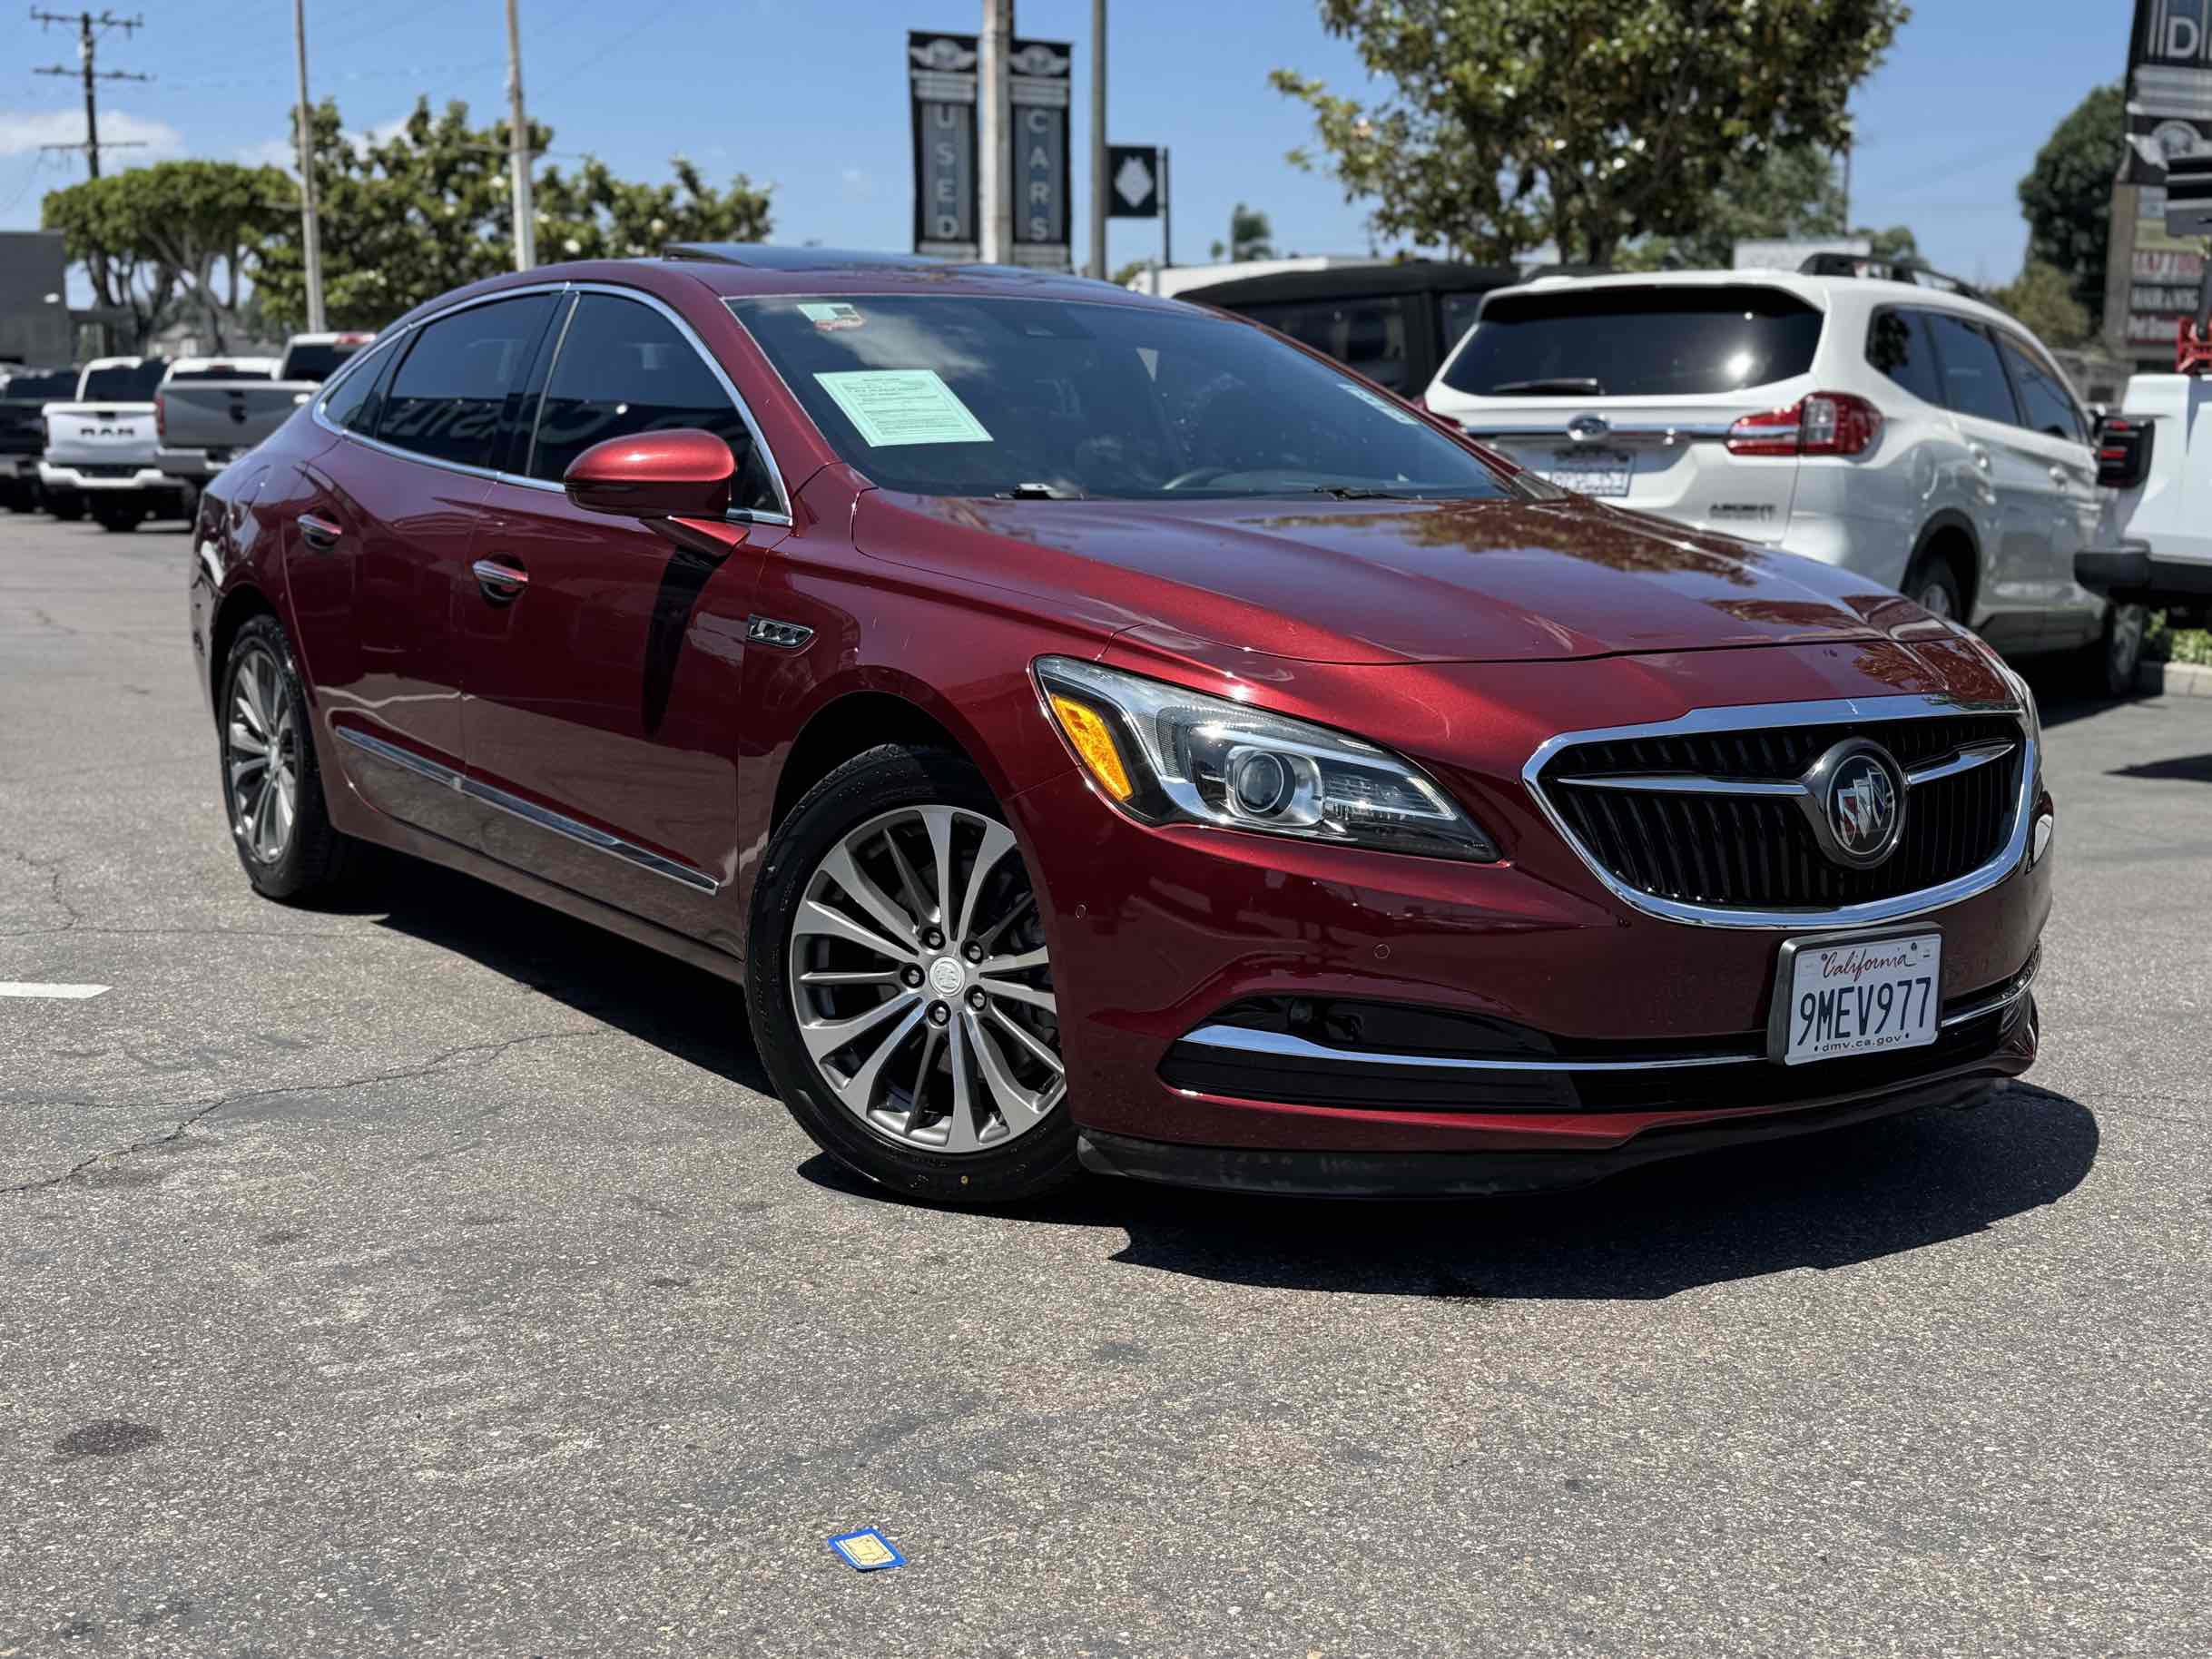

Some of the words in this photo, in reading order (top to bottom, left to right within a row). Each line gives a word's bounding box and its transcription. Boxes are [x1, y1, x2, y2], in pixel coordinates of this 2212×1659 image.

[936, 102, 959, 239] USED
[1027, 109, 1050, 241] CARS
[1823, 948, 1917, 982] California
[1797, 977, 1932, 1046] 9MEV977
[1822, 1035, 1902, 1053] dmv.ca.gov
